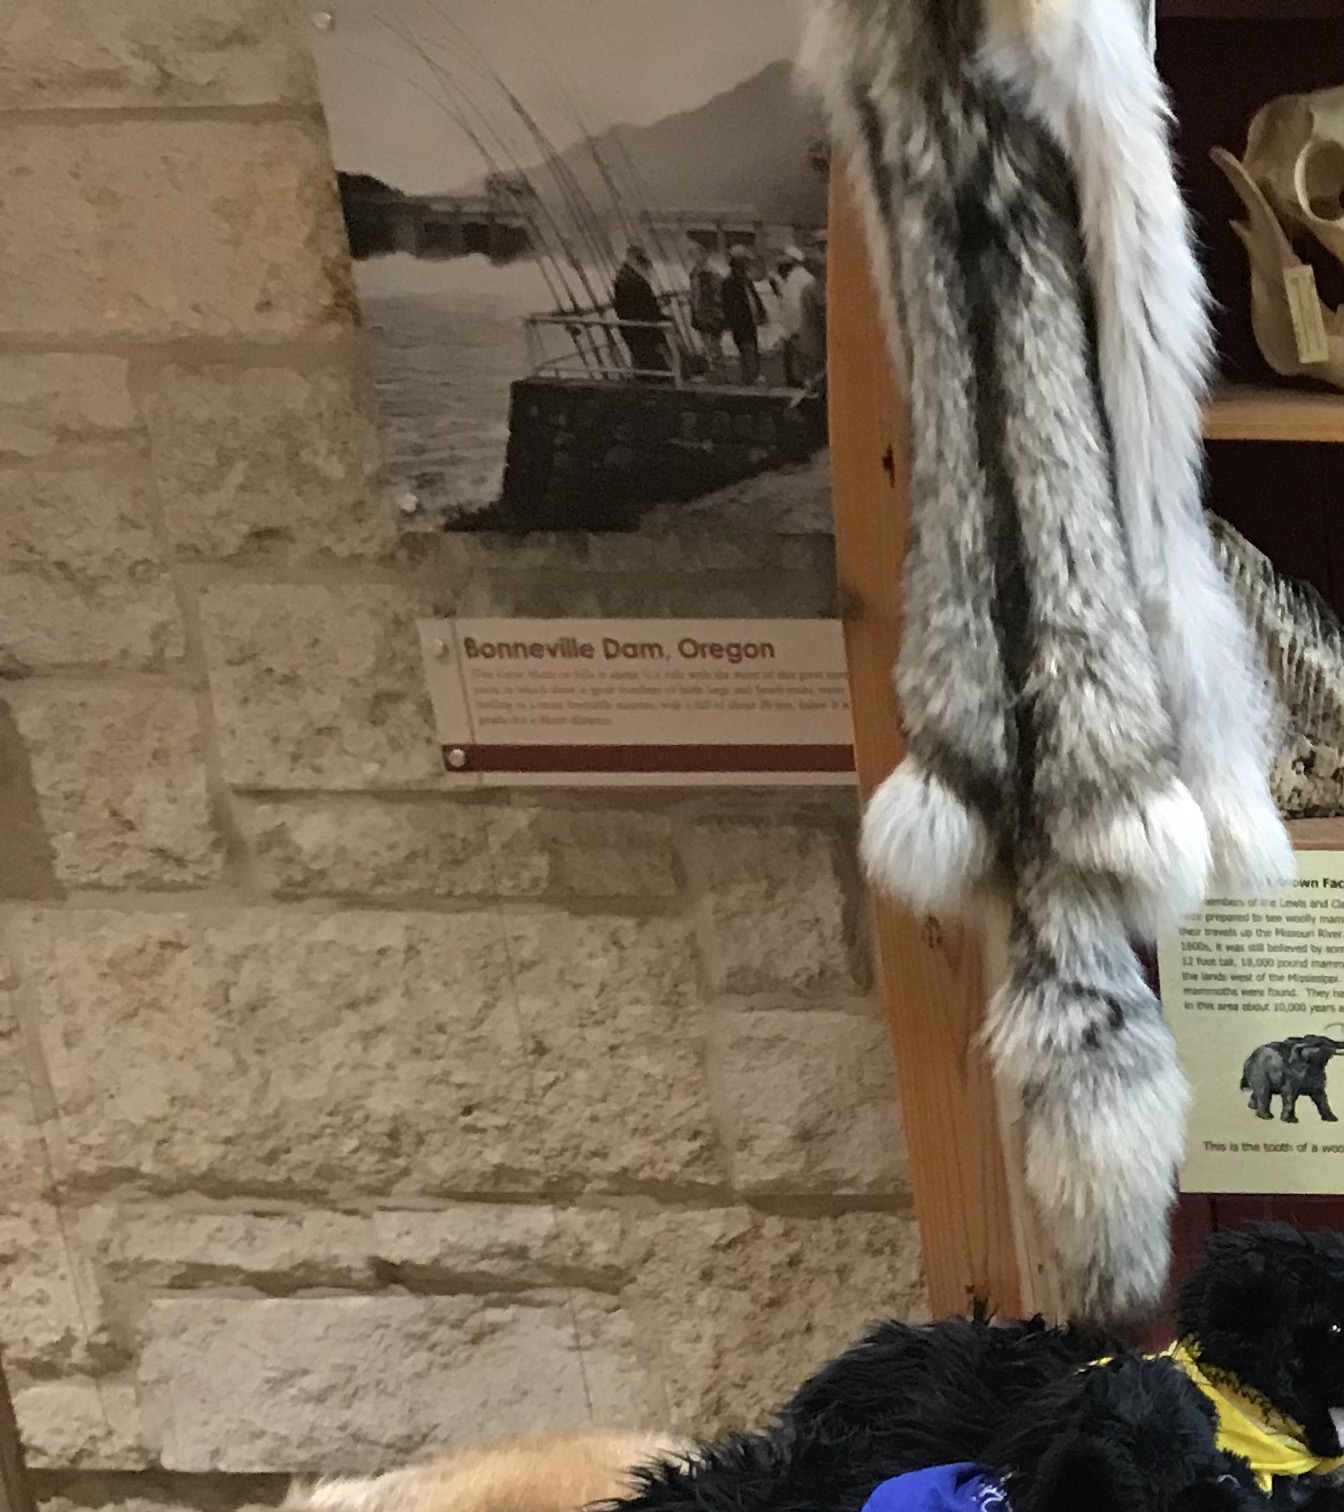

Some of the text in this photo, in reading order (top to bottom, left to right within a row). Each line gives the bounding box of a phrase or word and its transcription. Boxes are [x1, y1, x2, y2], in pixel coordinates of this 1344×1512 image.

[464, 636, 776, 664] Bonneville Dam, Oregon
[1205, 897, 1246, 908] embers
[1279, 898, 1307, 909] Lewis
[1309, 899, 1329, 909] and
[1255, 928, 1272, 938] the
[1267, 943, 1308, 953] believed
[1310, 943, 1323, 955] by
[1277, 958, 1308, 969] pound
[1182, 971, 1199, 982] the
[1255, 971, 1266, 983] of
[1268, 972, 1285, 983] the
[1306, 987, 1330, 999] They
[1309, 1003, 1336, 1015] years
[1202, 1140, 1227, 1152] This
[1229, 1141, 1239, 1153] is
[1241, 1141, 1260, 1153] the
[1262, 1141, 1294, 1153] tooth
[1296, 1142, 1308, 1153] of
[1311, 1144, 1319, 1153] a
